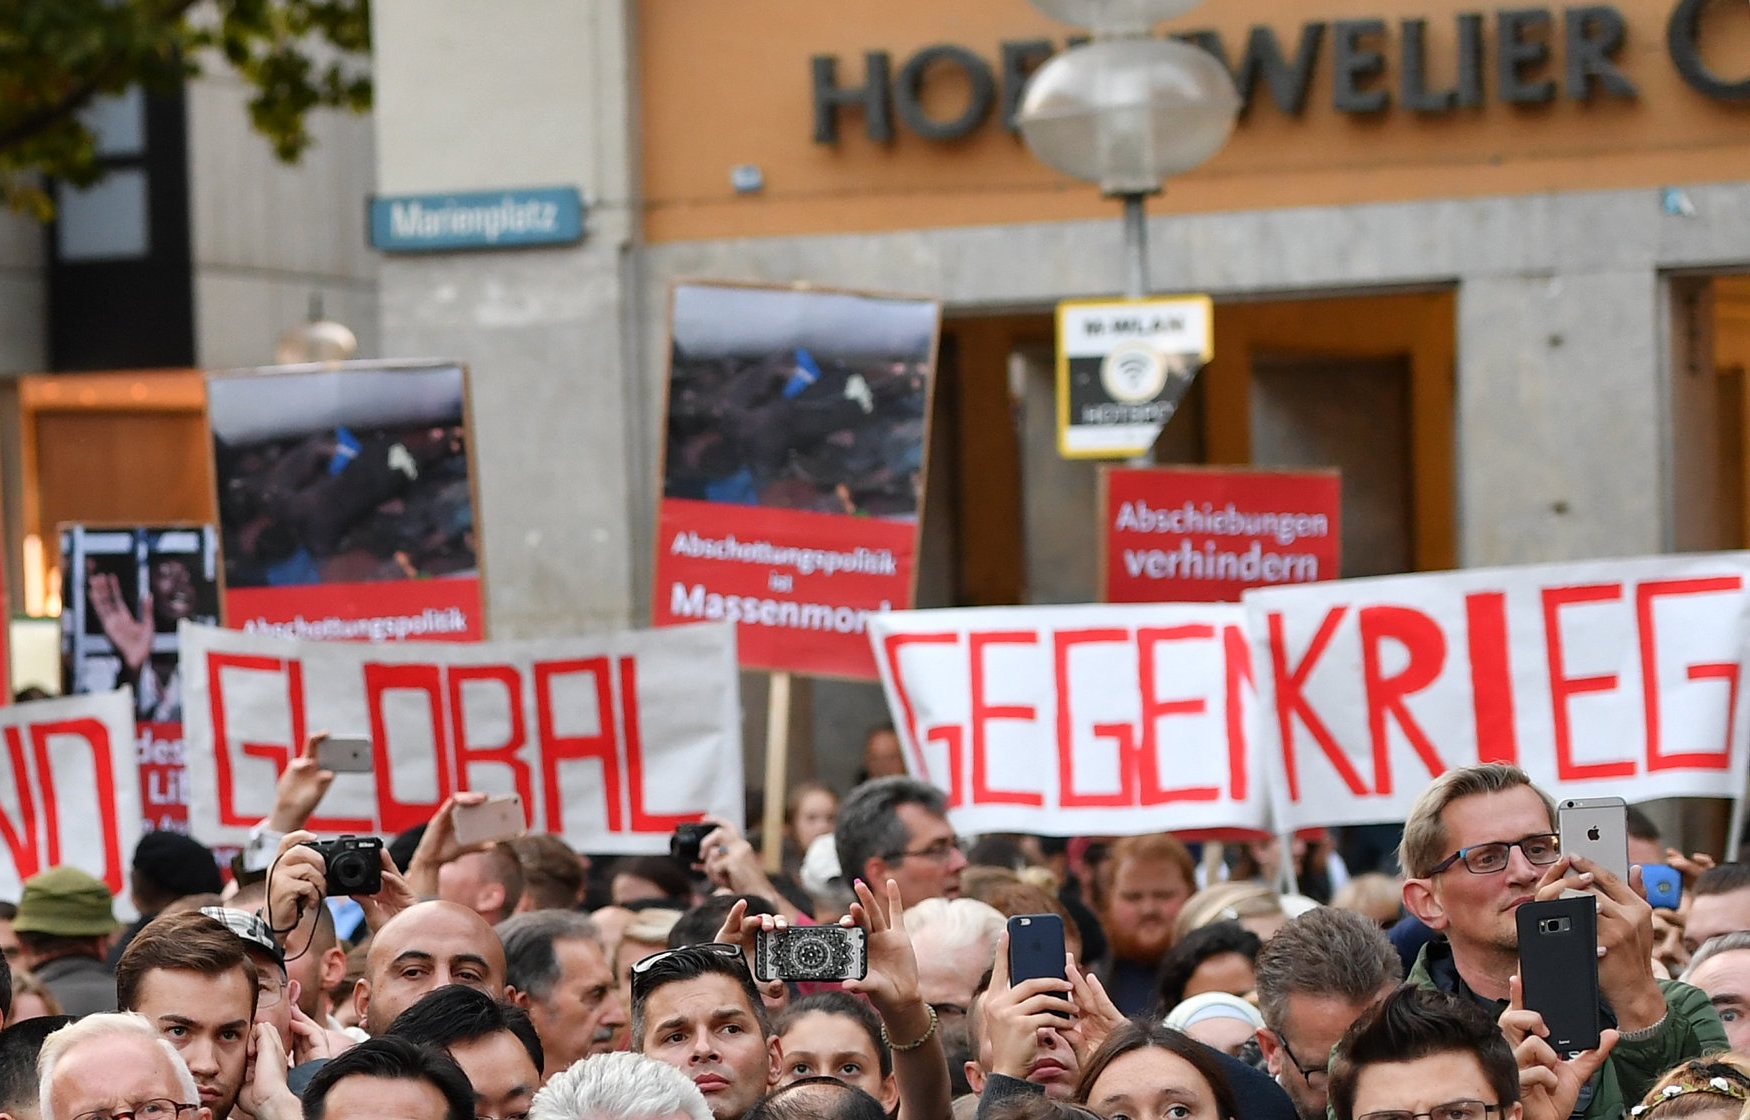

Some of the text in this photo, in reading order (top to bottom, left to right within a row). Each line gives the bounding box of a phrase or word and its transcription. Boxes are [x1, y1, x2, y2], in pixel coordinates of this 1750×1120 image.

[388, 197, 559, 242] Marienplatz
[1116, 499, 1329, 546] Abschiebungen
[670, 530, 897, 576] Abschottungspolitik
[1124, 537, 1319, 582] verhindern
[767, 569, 794, 593] ist
[1267, 574, 1743, 801] KRIEG
[208, 651, 706, 836] GLOBAL
